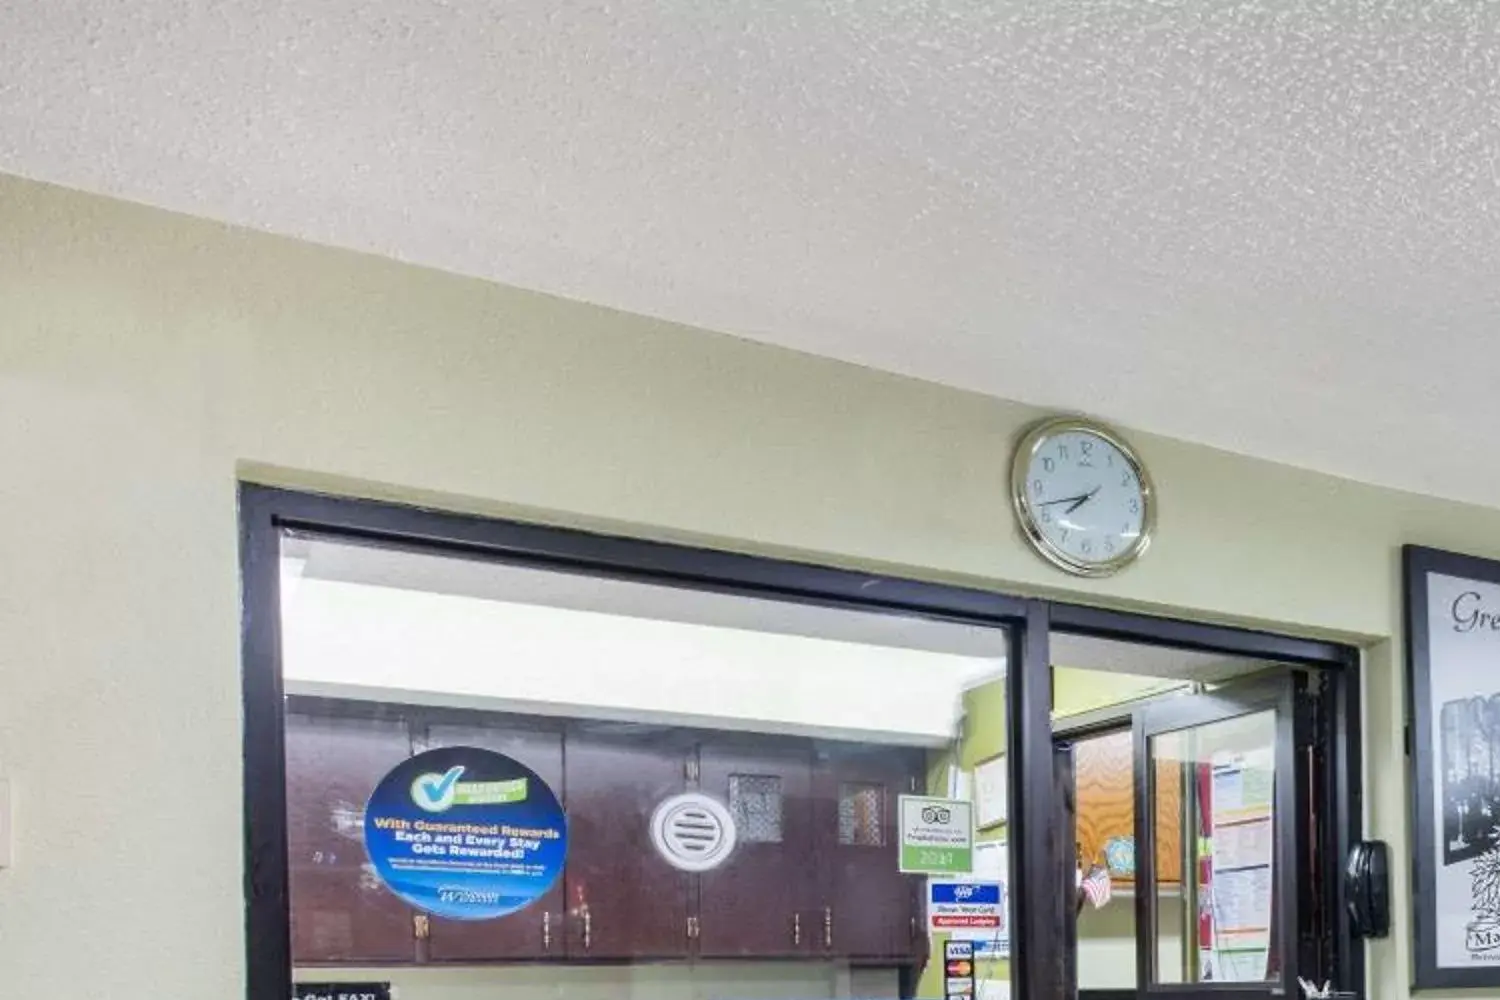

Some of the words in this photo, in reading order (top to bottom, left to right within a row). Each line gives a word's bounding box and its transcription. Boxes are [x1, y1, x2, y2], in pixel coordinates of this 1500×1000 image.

[374, 817, 410, 830] With
[413, 819, 501, 835] Guaranteed
[501, 825, 560, 839] Rewards
[395, 831, 432, 842] Each
[434, 832, 463, 845] and
[465, 834, 505, 848] Every
[509, 837, 541, 850] Stay
[411, 843, 446, 855] Gets
